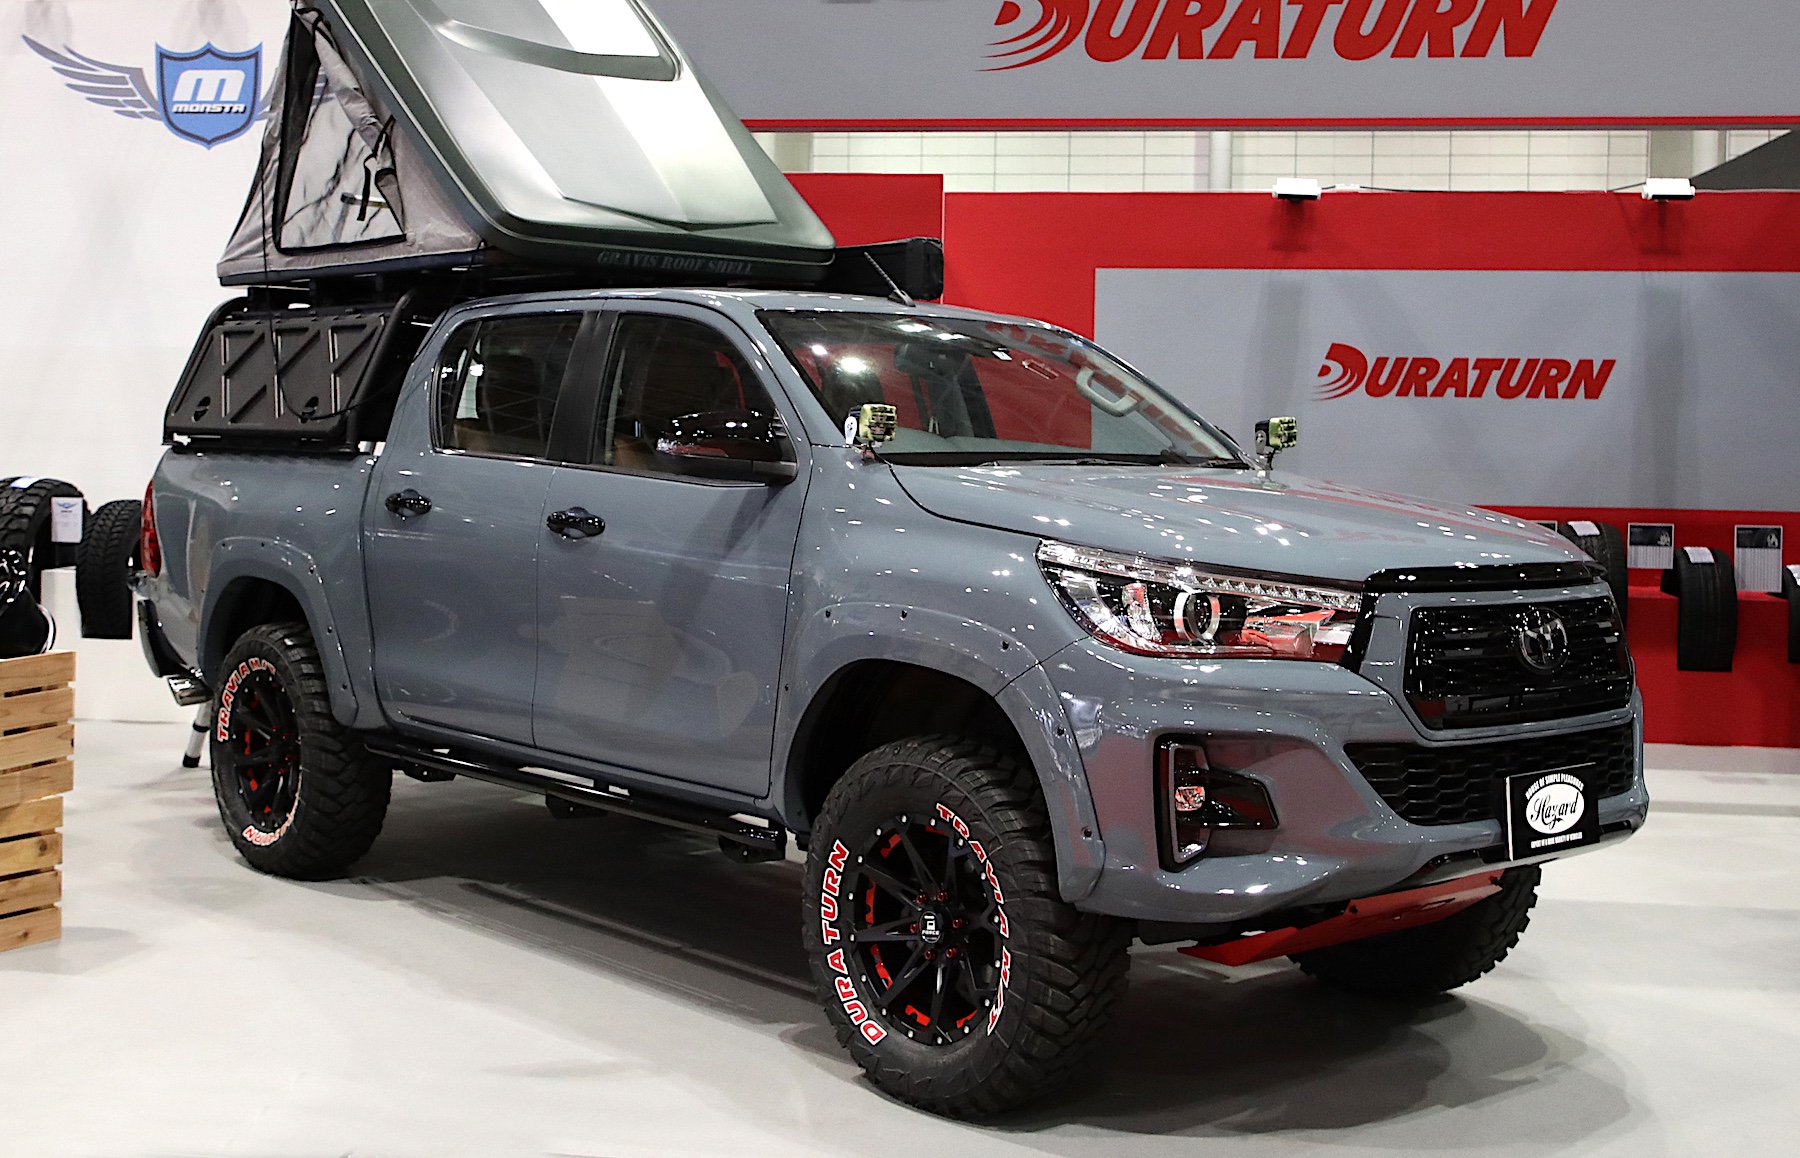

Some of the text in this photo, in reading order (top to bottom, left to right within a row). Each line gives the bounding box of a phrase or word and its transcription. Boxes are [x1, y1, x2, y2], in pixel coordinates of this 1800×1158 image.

[974, 0, 1556, 72] DURATURN
[172, 103, 246, 114] MONSTA
[597, 251, 754, 276] GRAVIS ROOF SHELL
[1312, 343, 1616, 401] DURATURN
[217, 662, 251, 742] TRAVIA
[1530, 791, 1579, 831] Hazard
[1539, 777, 1545, 787] OF
[936, 802, 1009, 938] TRAVIA
[821, 839, 887, 1046] DURATURN
